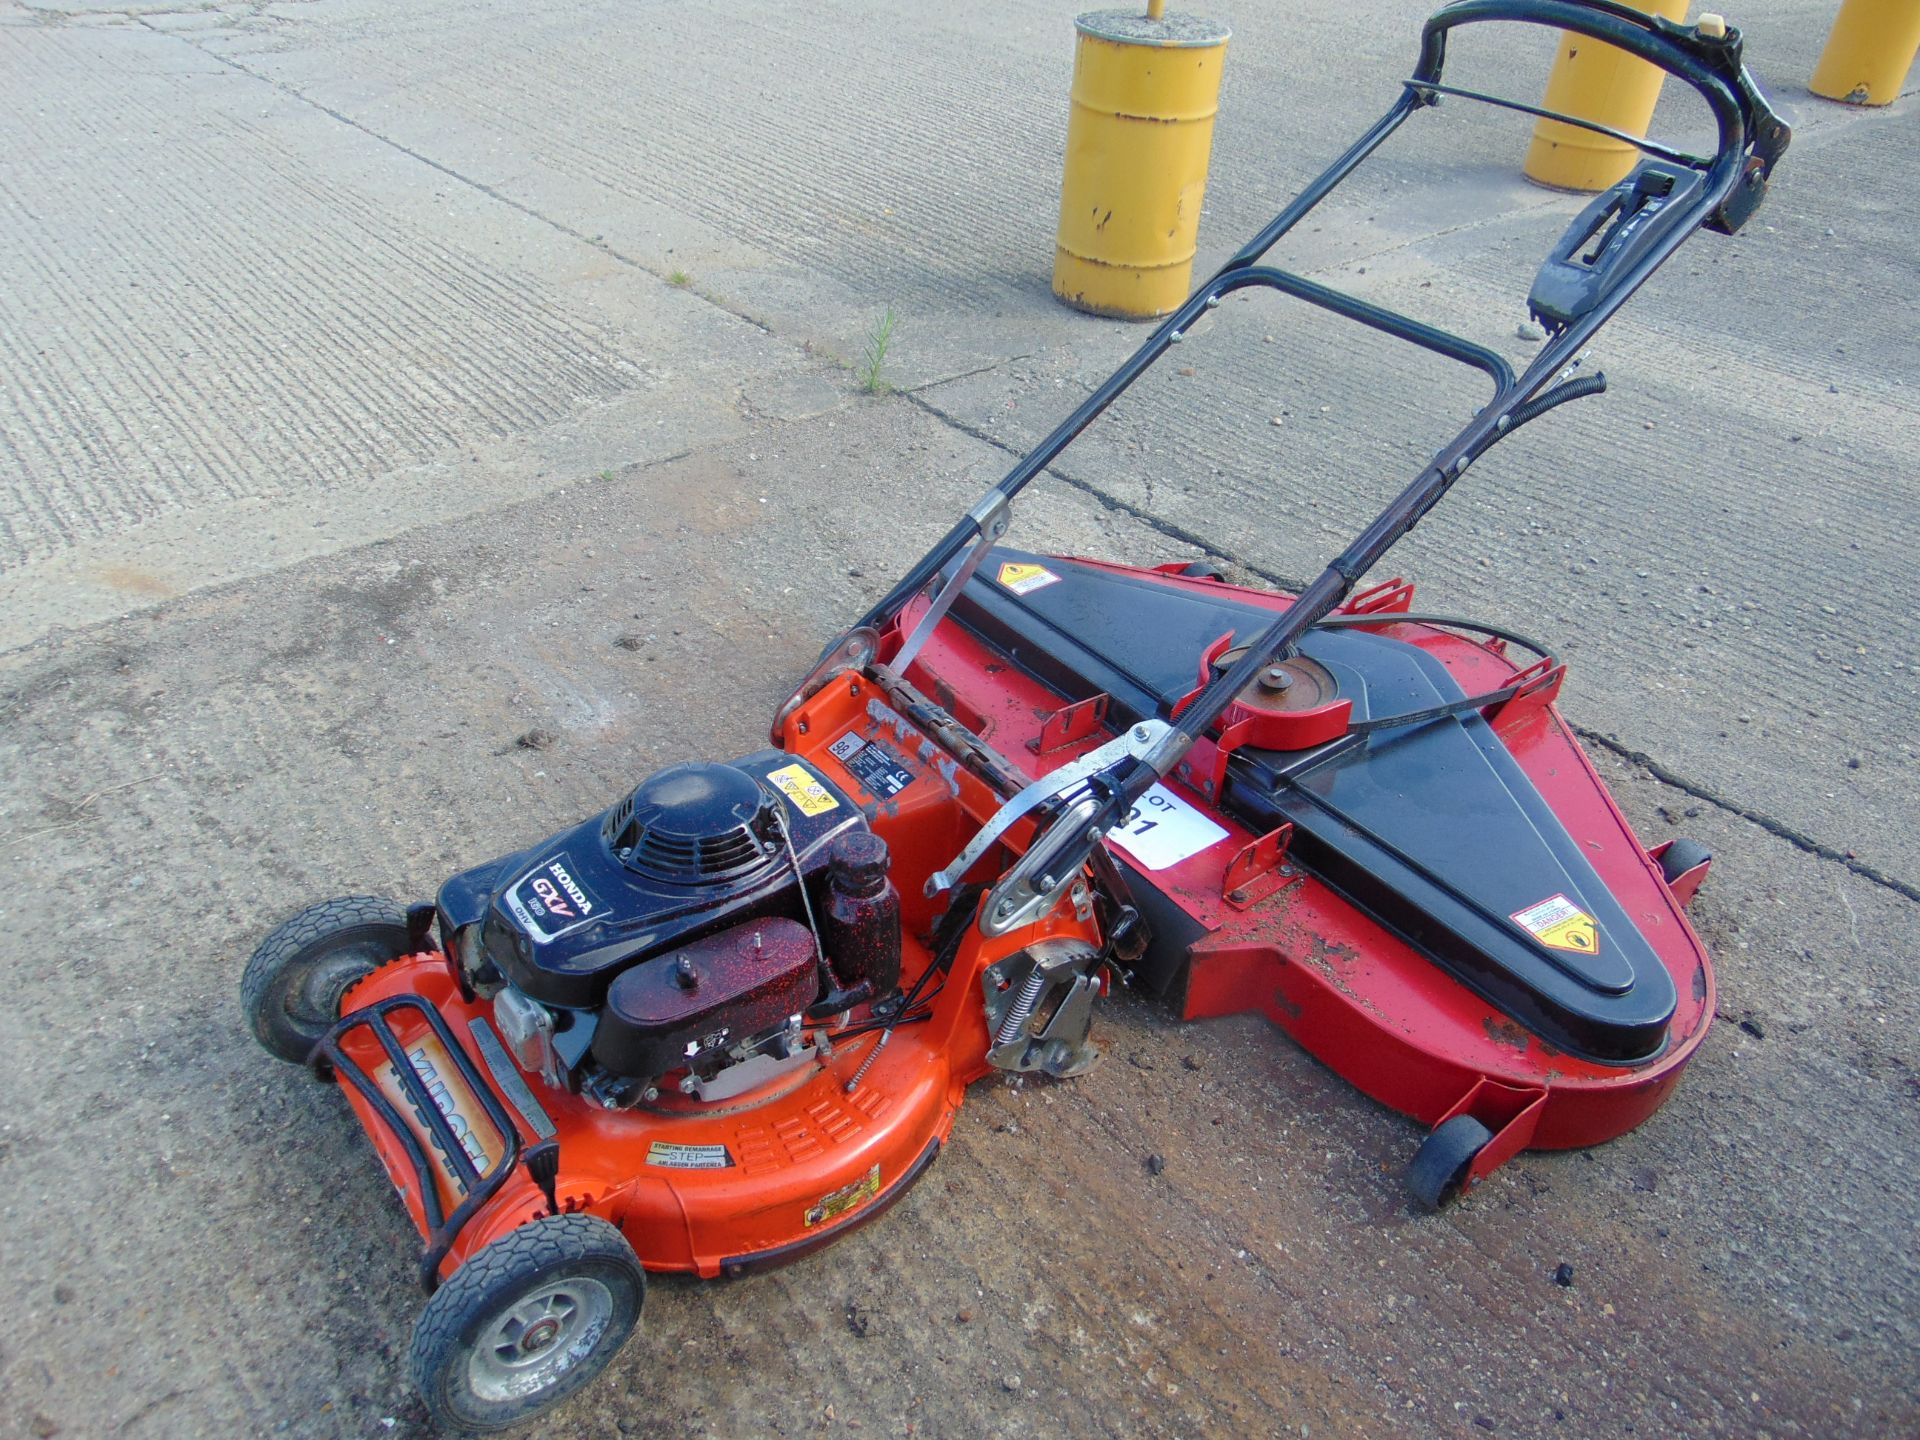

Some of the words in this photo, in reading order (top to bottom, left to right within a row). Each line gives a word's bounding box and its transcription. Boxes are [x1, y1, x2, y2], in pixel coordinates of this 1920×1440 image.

[832, 741, 850, 755] 98
[1141, 788, 1177, 812] OT
[549, 862, 593, 916] HONDA
[532, 878, 576, 919] GXV
[515, 907, 532, 925] OHV
[653, 1143, 683, 1152] STARTING
[669, 1152, 704, 1162] STEP
